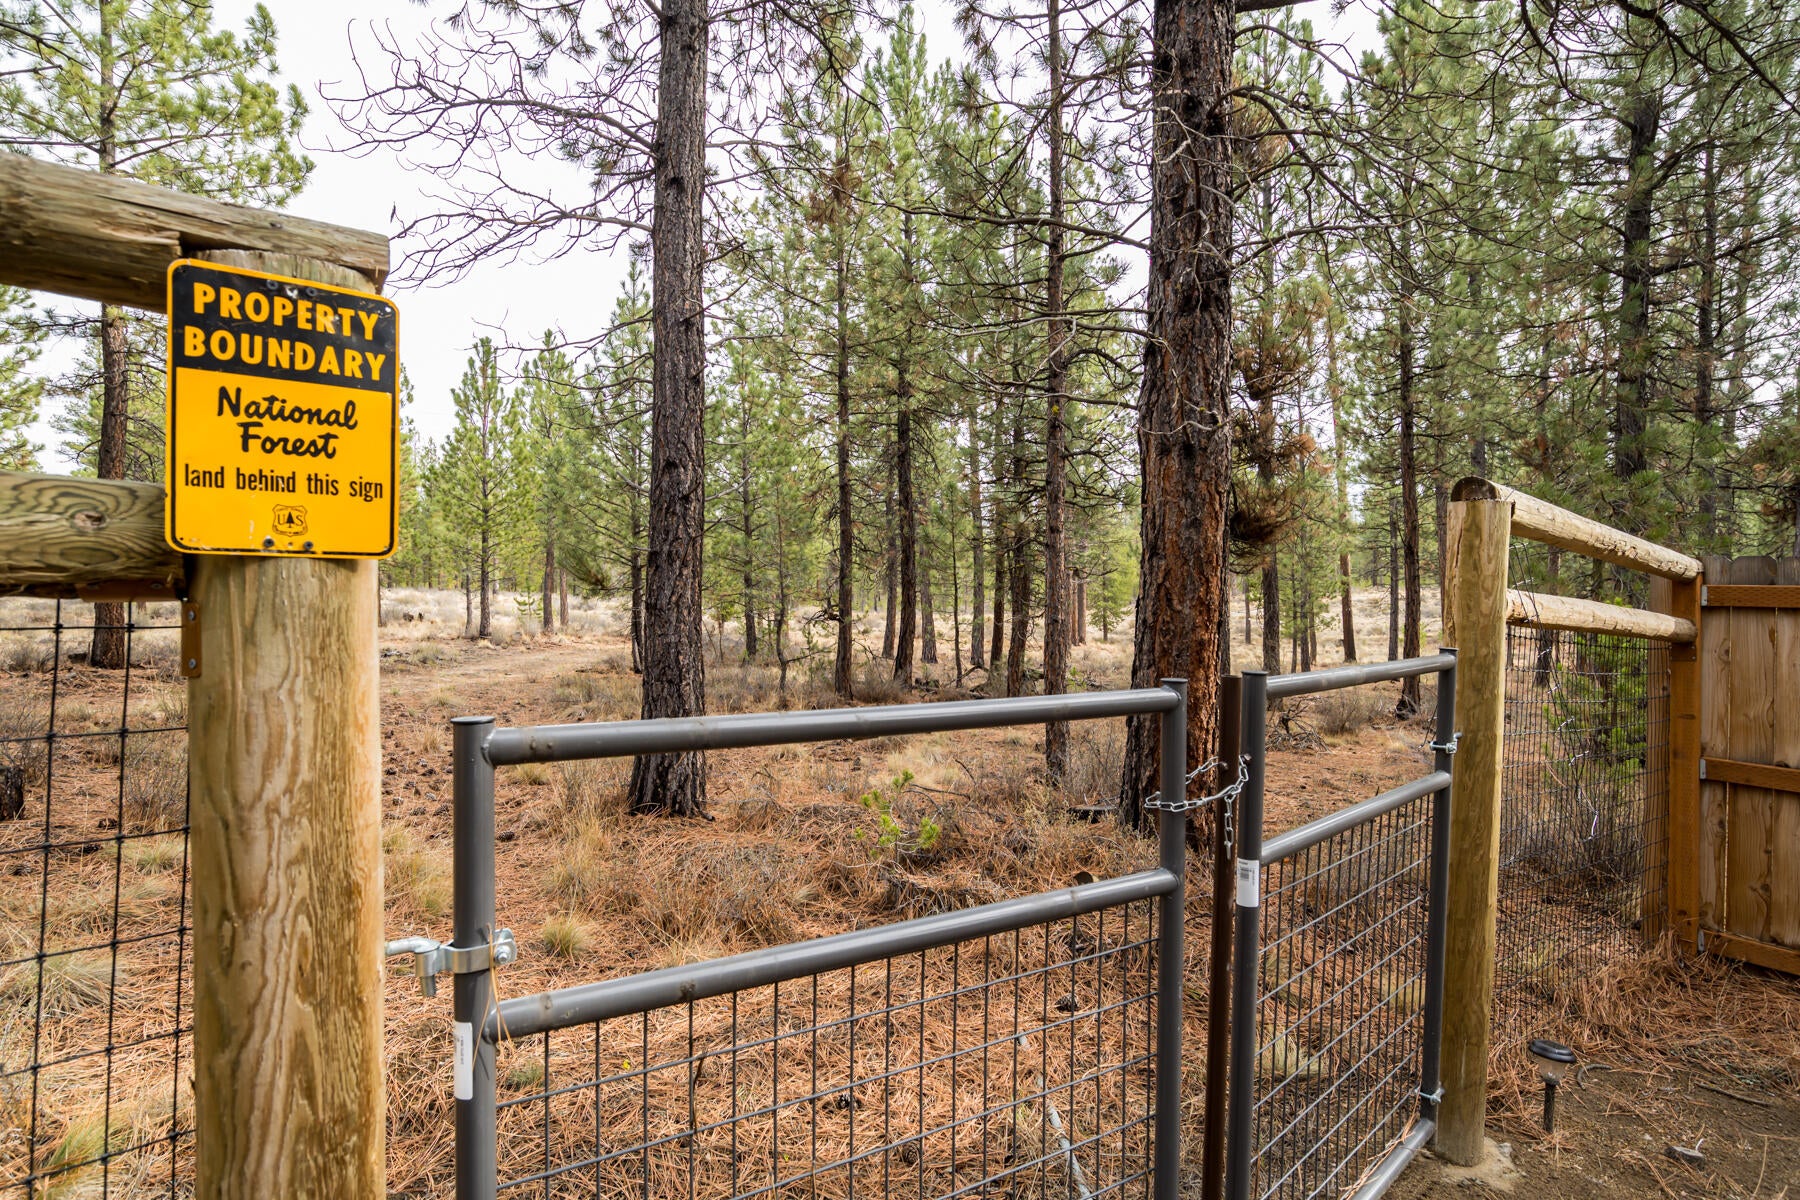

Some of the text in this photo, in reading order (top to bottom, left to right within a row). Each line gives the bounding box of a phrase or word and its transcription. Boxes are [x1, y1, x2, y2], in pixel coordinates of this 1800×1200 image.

[193, 282, 378, 341] PROPERTY
[184, 326, 386, 381] BOUNDARY
[217, 386, 358, 430] National
[237, 422, 339, 458] Forest
[184, 464, 383, 502] land behind this sign
